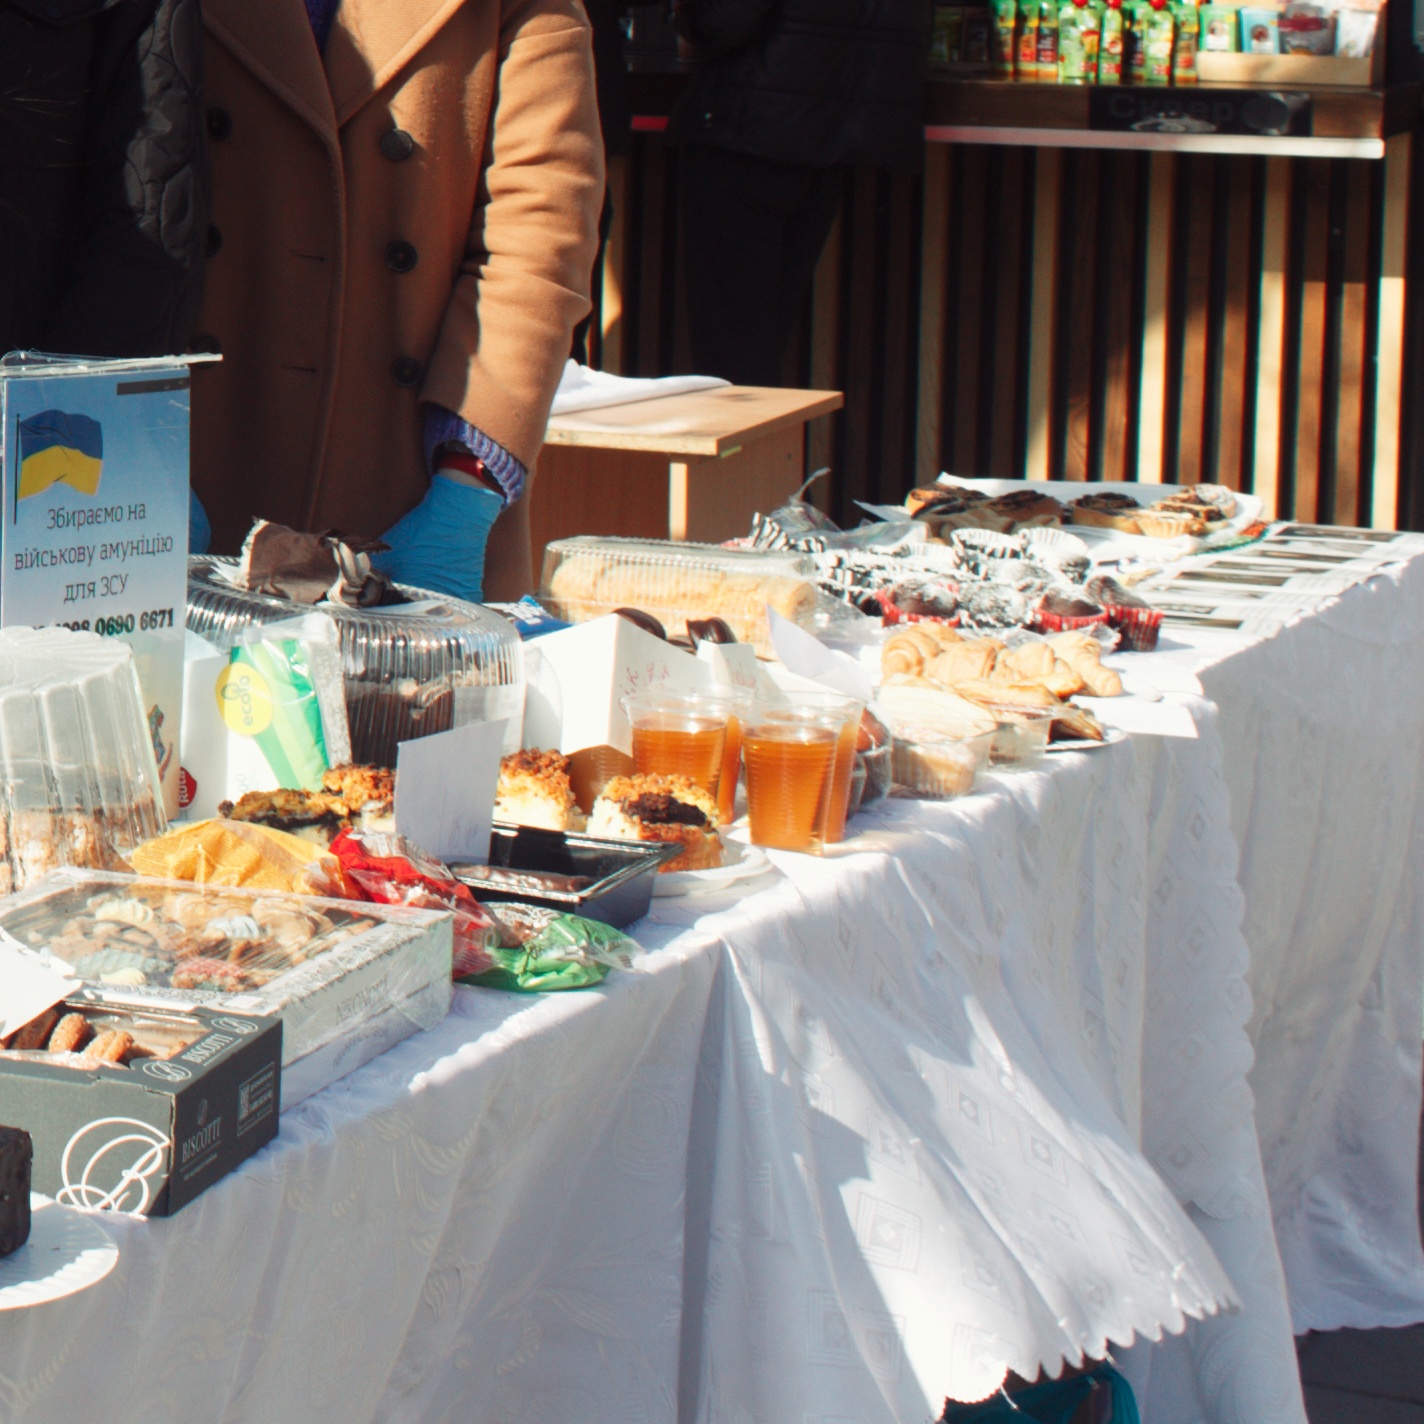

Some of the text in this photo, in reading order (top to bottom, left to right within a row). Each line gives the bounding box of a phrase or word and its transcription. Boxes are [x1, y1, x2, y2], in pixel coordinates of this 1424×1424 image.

[47, 503, 147, 531] Збираємо на
[14, 533, 174, 570] військову амуніцію
[64, 573, 129, 604] для ЗСУ
[94, 613, 135, 637] 0690
[140, 608, 174, 631] 6671
[182, 1116, 222, 1163] BISCOTTI
